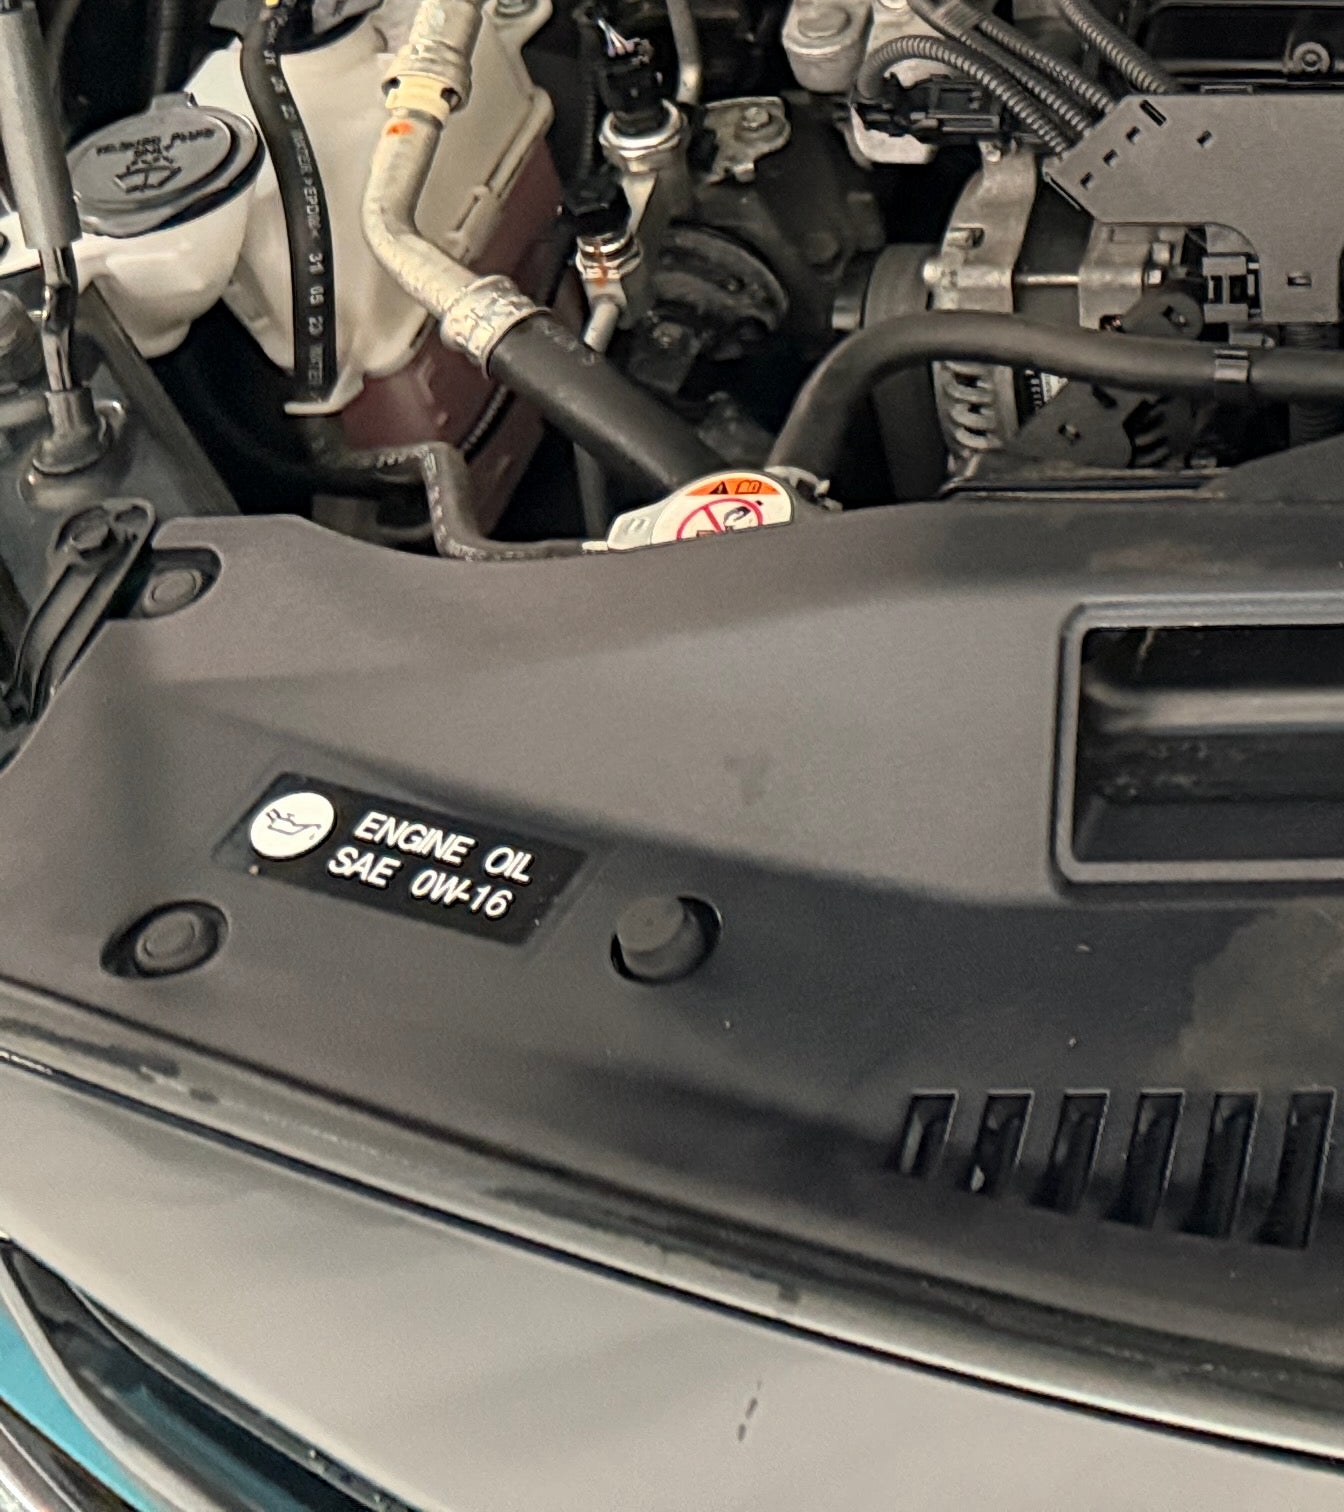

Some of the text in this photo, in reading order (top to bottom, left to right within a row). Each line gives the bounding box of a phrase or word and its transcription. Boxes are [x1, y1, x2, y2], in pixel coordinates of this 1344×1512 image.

[328, 846, 513, 919] SAE 0W-16
[354, 811, 534, 883] ENGINE OIL
